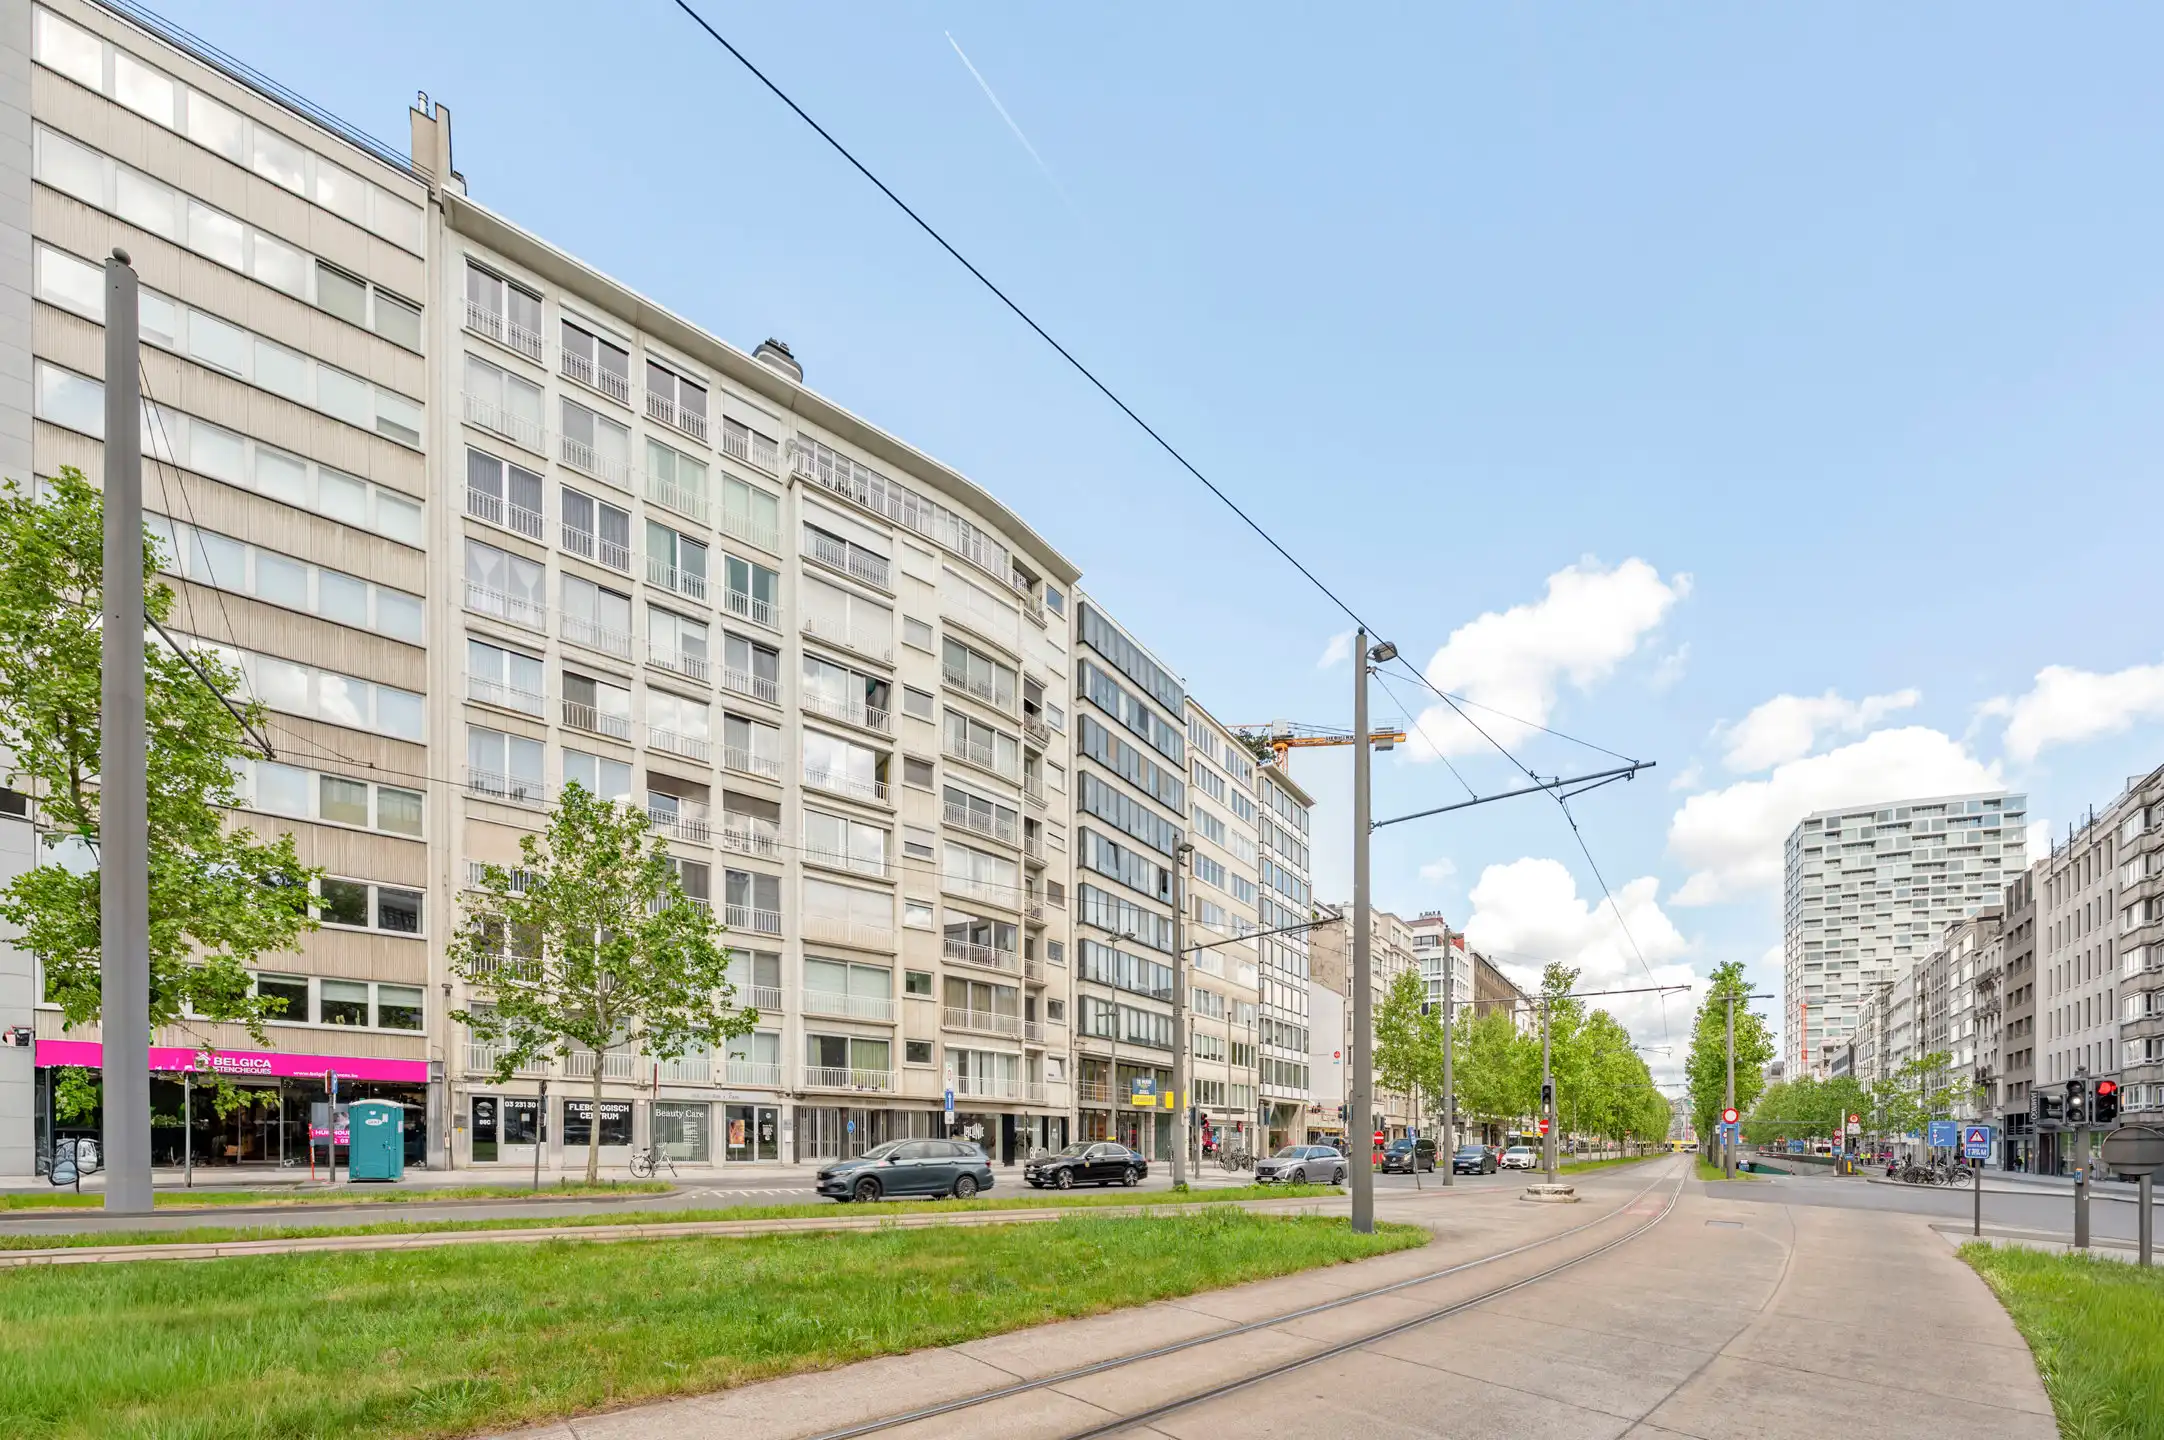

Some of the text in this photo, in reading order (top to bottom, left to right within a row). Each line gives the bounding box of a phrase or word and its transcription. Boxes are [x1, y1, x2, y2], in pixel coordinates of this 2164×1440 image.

[213, 1057, 271, 1068] BELGICA
[655, 1108, 704, 1119] Beauty Care
